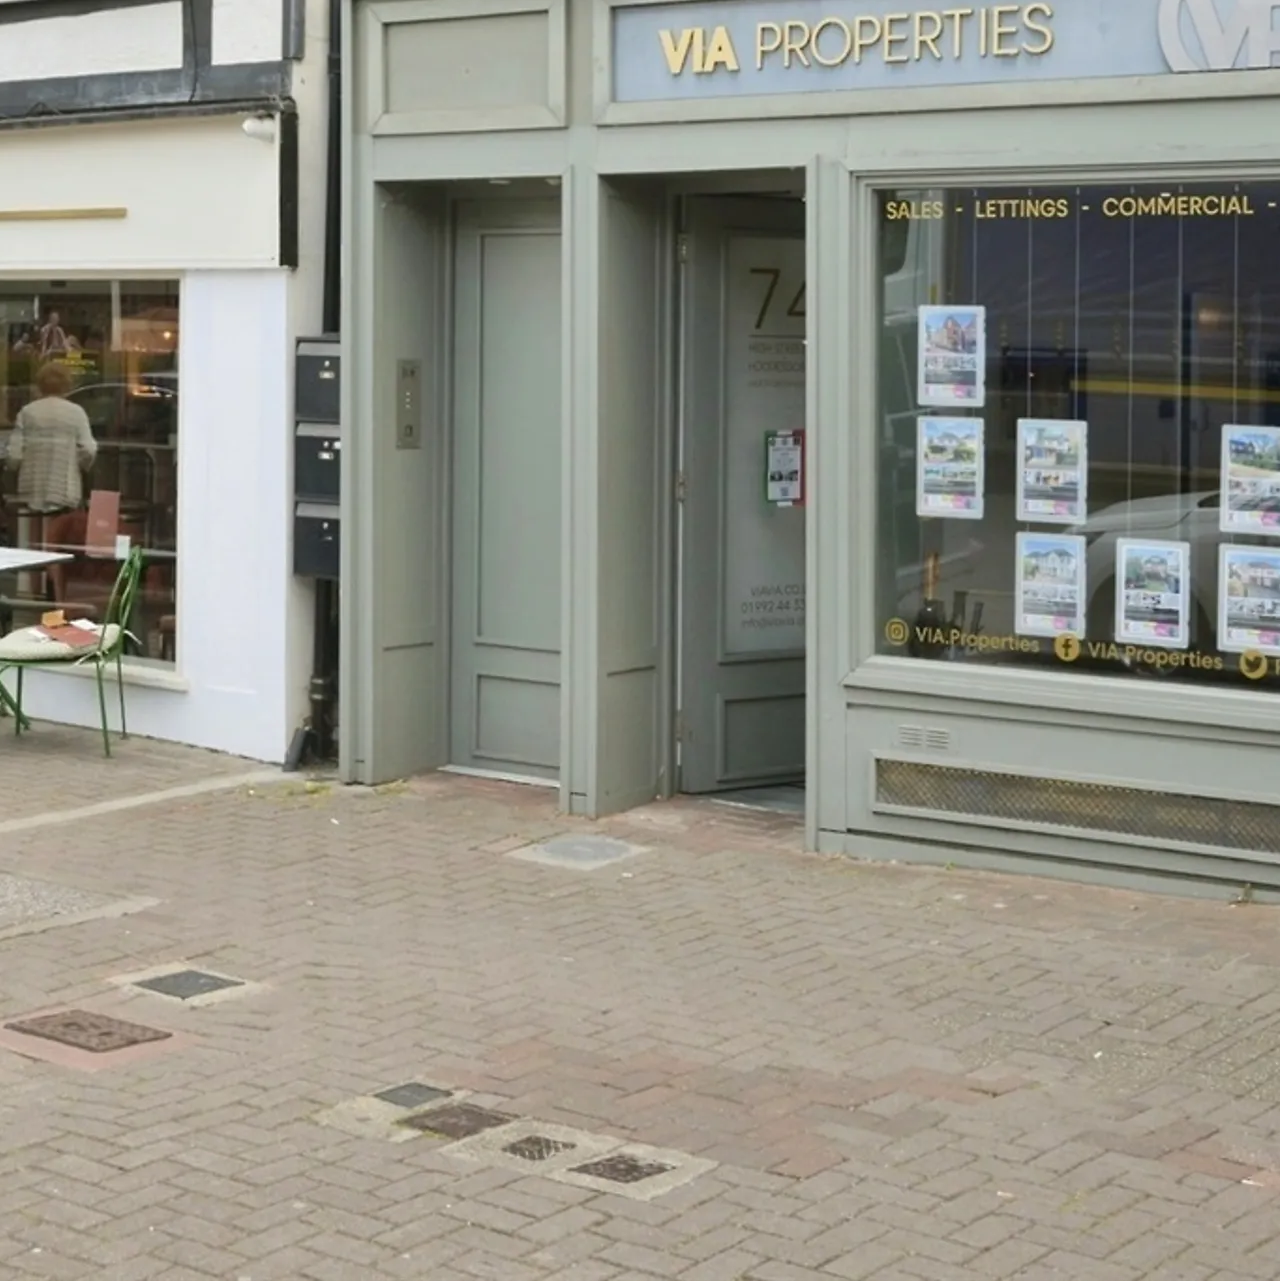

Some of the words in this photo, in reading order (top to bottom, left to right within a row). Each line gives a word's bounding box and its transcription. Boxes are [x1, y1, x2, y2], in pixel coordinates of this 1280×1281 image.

[658, 26, 740, 75] VIA
[755, 3, 1054, 70] PROPERTIES
[885, 201, 944, 220] SALES
[975, 199, 1069, 218] LETTINGS
[1102, 195, 1254, 217] COMMERCIAL
